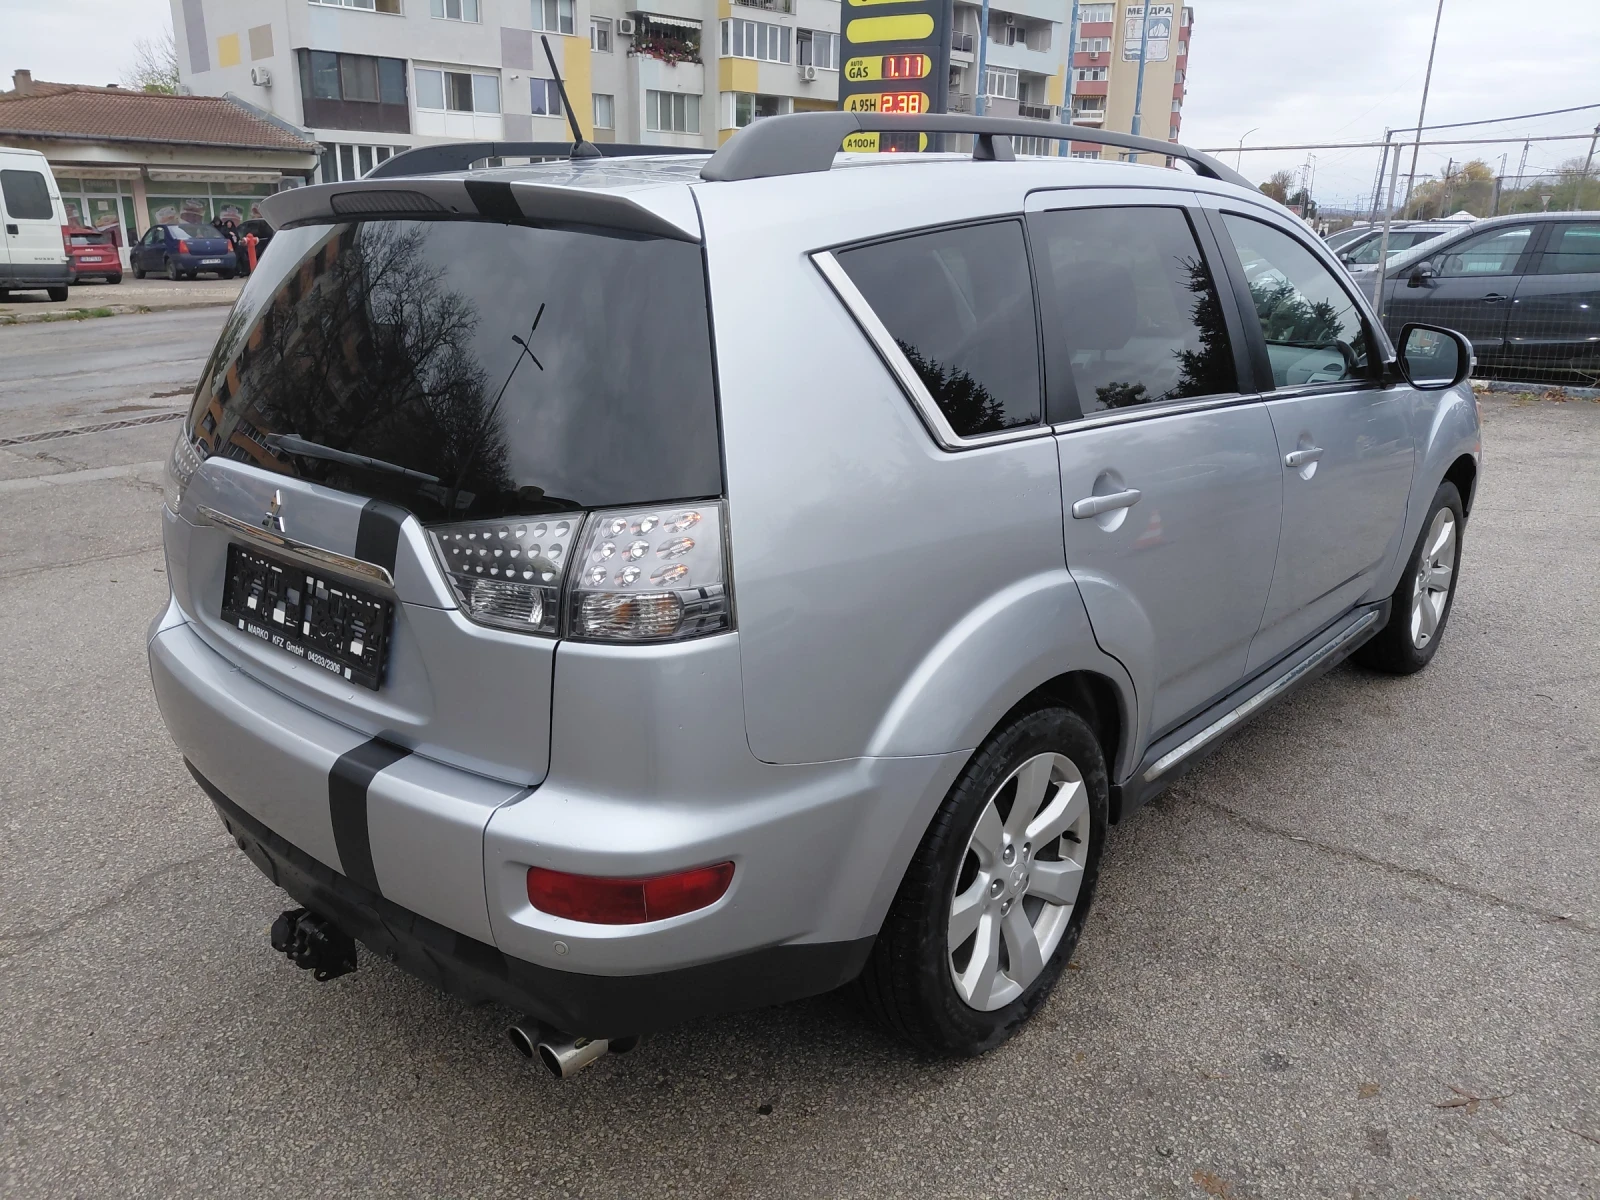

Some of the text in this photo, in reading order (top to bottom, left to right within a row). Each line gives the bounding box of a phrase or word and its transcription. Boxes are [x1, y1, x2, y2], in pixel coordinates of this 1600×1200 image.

[1127, 6, 1172, 15] МЕДРА
[849, 66, 869, 79] GAS
[889, 56, 922, 77] 1.11
[882, 94, 920, 113] 2.38
[247, 623, 341, 674] MARKO KFZ GmbH 04233/2306
